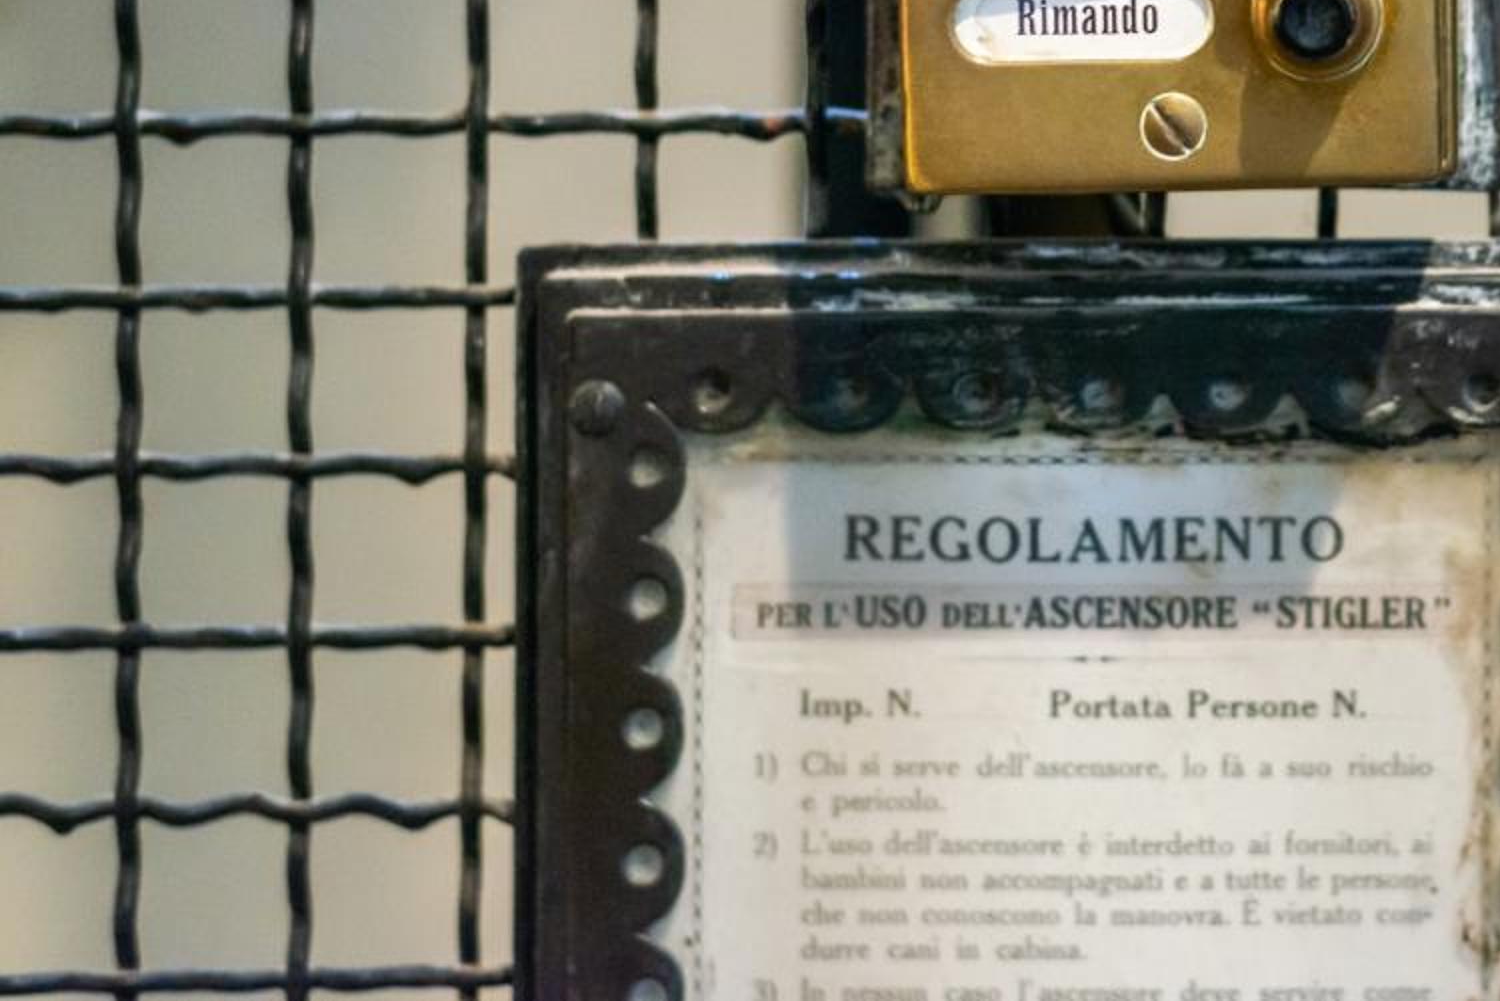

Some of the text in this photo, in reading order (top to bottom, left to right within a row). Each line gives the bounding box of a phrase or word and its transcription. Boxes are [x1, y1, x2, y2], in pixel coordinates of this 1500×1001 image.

[843, 513, 1344, 564] REGOLAMENTO
[756, 601, 813, 629] PER
[823, 595, 928, 629] L'USO
[941, 596, 1239, 630] DELL'ASCENSORE
[800, 689, 922, 725] Imp. N.
[1049, 689, 1367, 718] Portata Persone N.
[754, 752, 779, 784] 1)
[801, 750, 847, 777] Chi
[858, 754, 881, 777] si
[892, 760, 960, 777] serve
[1181, 752, 1208, 778] lo
[1258, 760, 1274, 778] a
[1285, 760, 1332, 777] suo
[1348, 751, 1435, 778] rischio
[801, 786, 946, 818] e pericolo.
[752, 831, 778, 861] 2)
[800, 829, 873, 856] L'uso
[1105, 830, 1235, 856] interdetto
[1247, 832, 1272, 856] ai
[1284, 829, 1400, 858] fornitori,
[1410, 831, 1434, 856] ai
[801, 866, 906, 891] bambini
[919, 874, 969, 891] non
[982, 869, 1164, 899] accompagnati
[1173, 874, 1189, 891] e
[1200, 874, 1215, 891] a
[1224, 869, 1287, 891] tutte
[1297, 865, 1320, 891] le
[801, 899, 846, 926] che
[858, 909, 909, 926] non
[920, 909, 1062, 927] conoscono
[1073, 901, 1098, 927] la
[1109, 909, 1233, 927] manovra.
[1273, 902, 1363, 926] vietato
[800, 935, 870, 961] durre
[886, 937, 941, 961] cani
[955, 937, 981, 961] in
